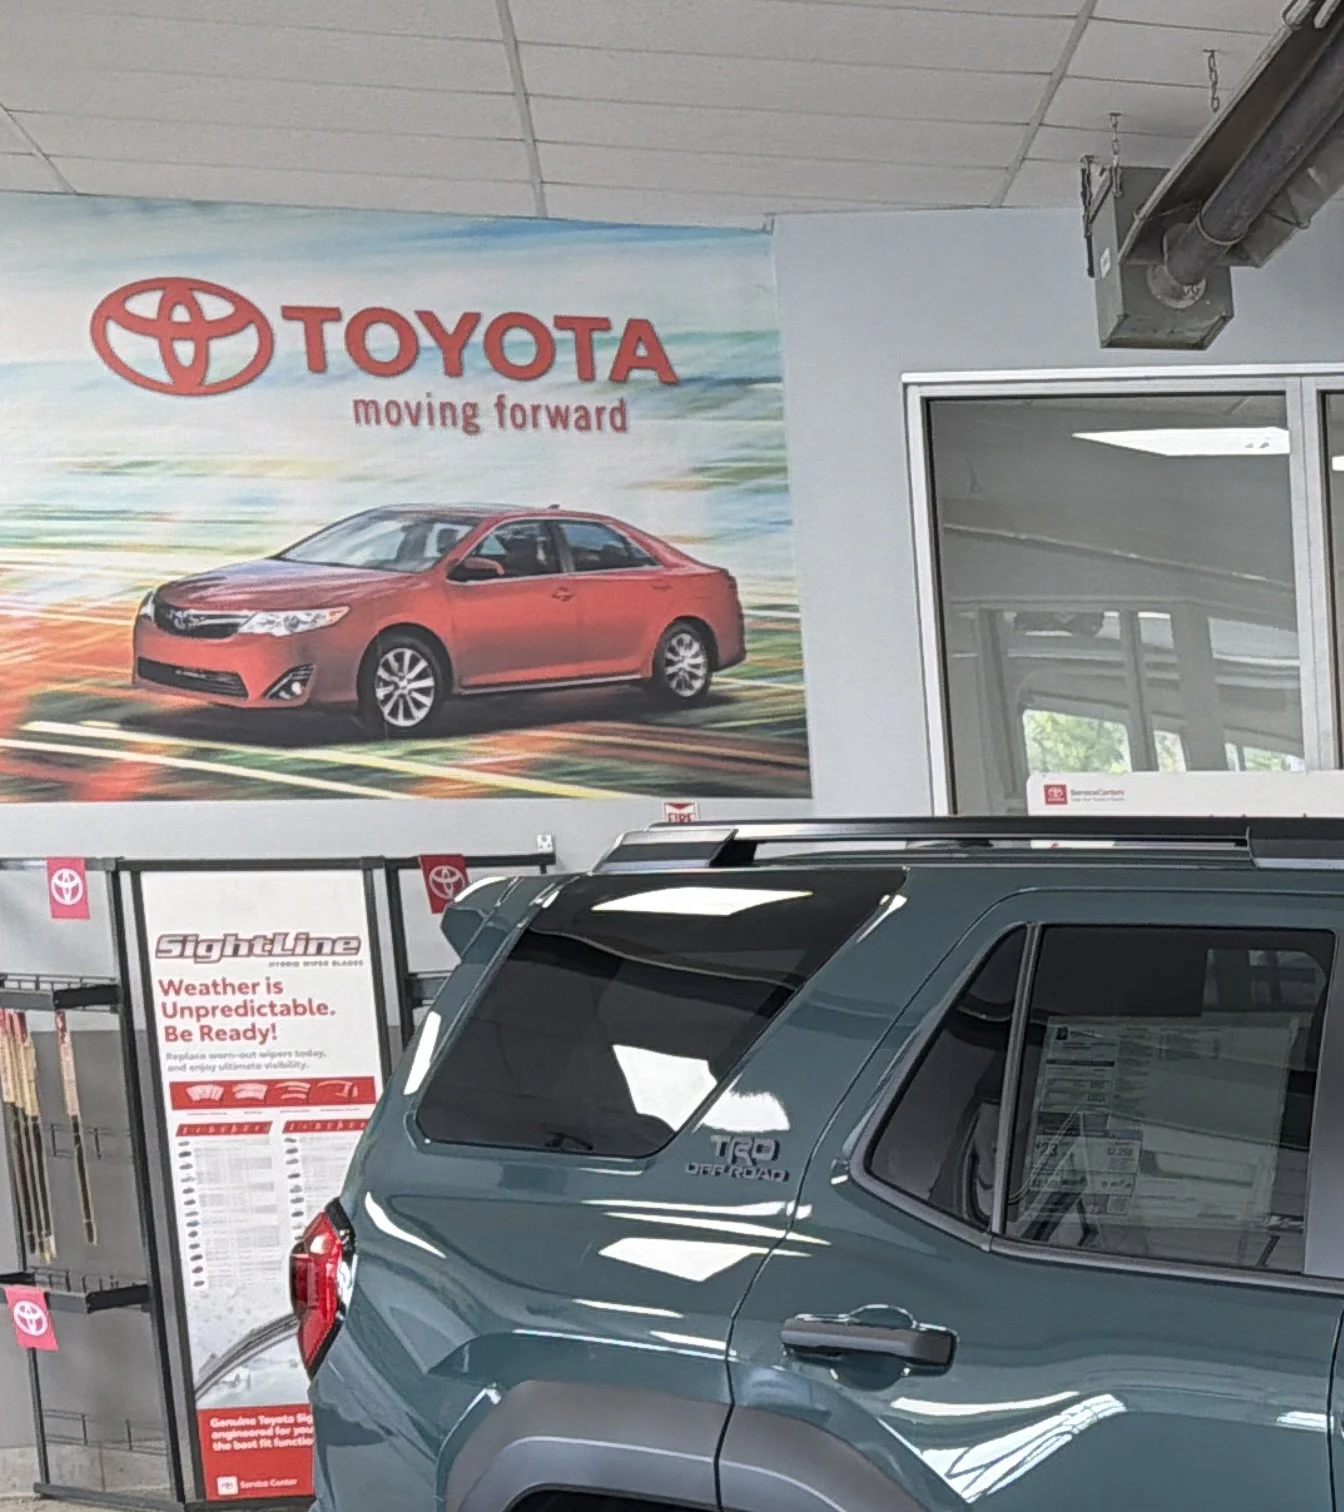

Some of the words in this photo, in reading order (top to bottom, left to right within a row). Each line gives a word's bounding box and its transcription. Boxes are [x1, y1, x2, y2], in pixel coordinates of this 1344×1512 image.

[281, 304, 680, 386] TOYOTA
[352, 393, 481, 435] moving
[494, 394, 628, 433] forward
[155, 932, 362, 964] SightLine
[158, 978, 260, 996] Weather
[265, 976, 284, 995] is
[161, 998, 336, 1022] Unpredictable.
[164, 1025, 193, 1042] Be
[199, 1023, 277, 1044] Ready!
[166, 1053, 206, 1062] Replace
[259, 1051, 292, 1061] wipers
[168, 1063, 187, 1072] and
[189, 1063, 217, 1074] enjoy
[219, 1061, 262, 1071] ultimate
[711, 1135, 779, 1165] TRD
[729, 1165, 790, 1182] ROAD
[274, 1426, 291, 1436] for
